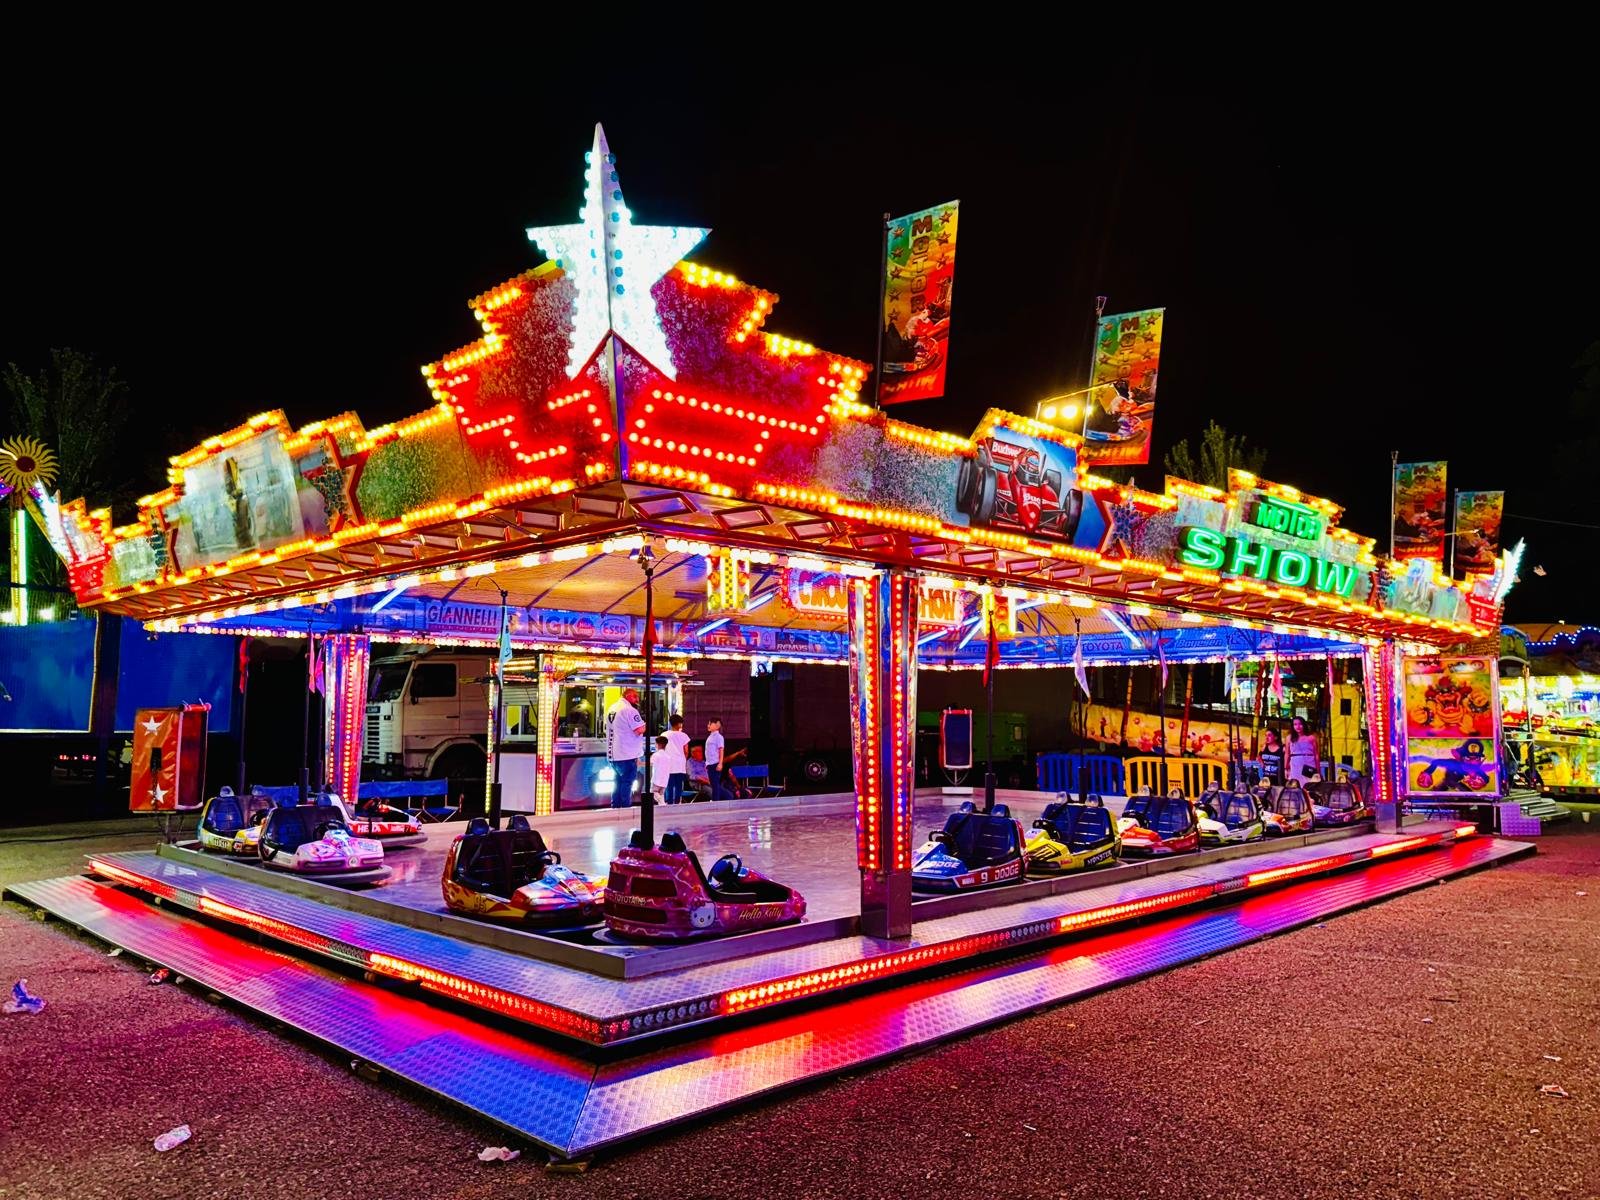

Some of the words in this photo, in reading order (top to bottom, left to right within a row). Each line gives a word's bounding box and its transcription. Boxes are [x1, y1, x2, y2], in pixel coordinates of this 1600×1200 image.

[910, 214, 933, 314] MOTOR
[1256, 502, 1322, 541] MOTOR
[1182, 526, 1360, 598] SHOW
[428, 605, 497, 626] GIANNELLI
[527, 614, 578, 636] NGK
[776, 643, 809, 652] REMUS
[1082, 641, 1123, 652] TOYOTA
[980, 871, 989, 883] 9
[994, 863, 1020, 881] DODGE
[738, 908, 762, 920] Hello
[764, 905, 782, 919] Kitty
